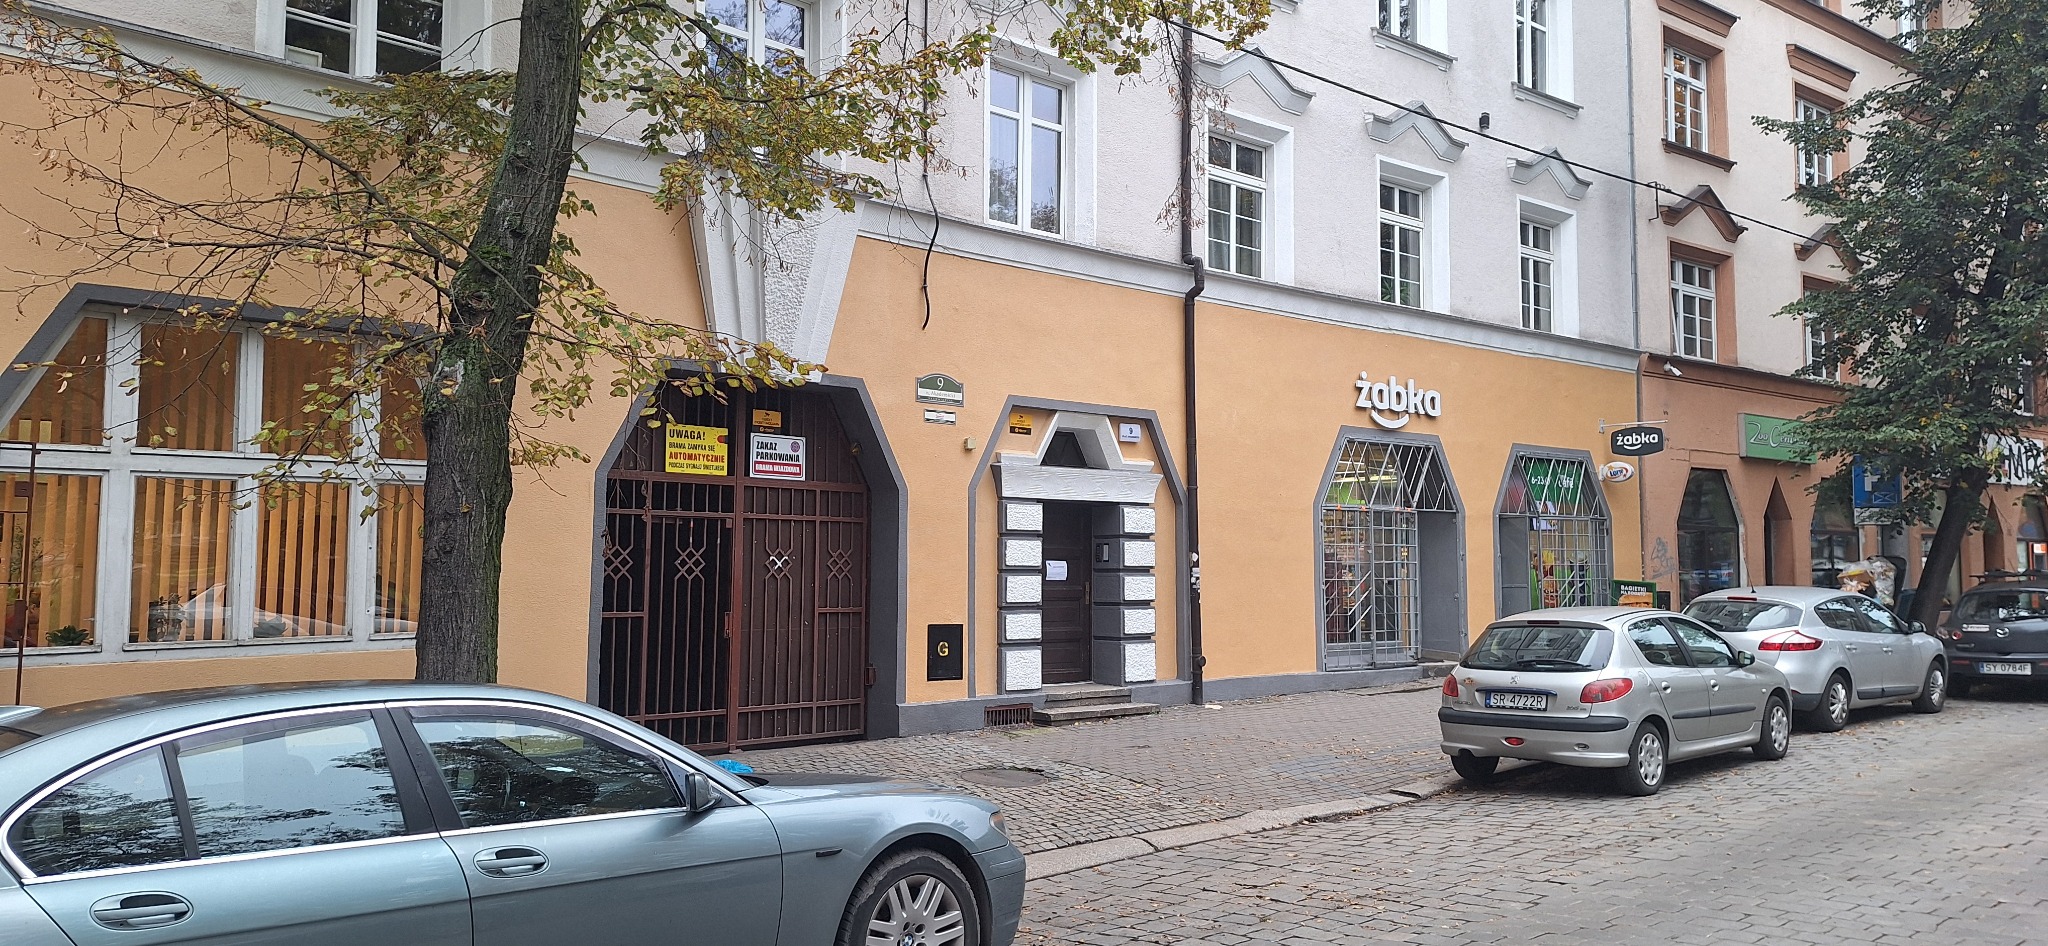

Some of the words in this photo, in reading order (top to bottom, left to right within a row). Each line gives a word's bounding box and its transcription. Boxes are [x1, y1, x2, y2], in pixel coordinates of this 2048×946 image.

[937, 377, 944, 390] 9
[1355, 371, 1441, 417] żabka
[669, 429, 706, 441] UWAGA!
[1129, 427, 1134, 435] 9
[1748, 421, 1768, 444] Zoo
[1616, 432, 1659, 446] żabka
[668, 442, 687, 450] BRAMA
[687, 443, 707, 451] ZAMYKA
[707, 445, 716, 453] SIĘ
[756, 441, 778, 451] ZAKAZ
[668, 451, 725, 463] AUTOMATYCZNIE
[755, 451, 800, 463] PARKOWANIA
[937, 641, 949, 657] G
[1985, 664, 1999, 672] SY
[2000, 664, 2029, 672] 0784F
[1492, 693, 1506, 703] SR
[1509, 694, 1544, 707] 4722R
